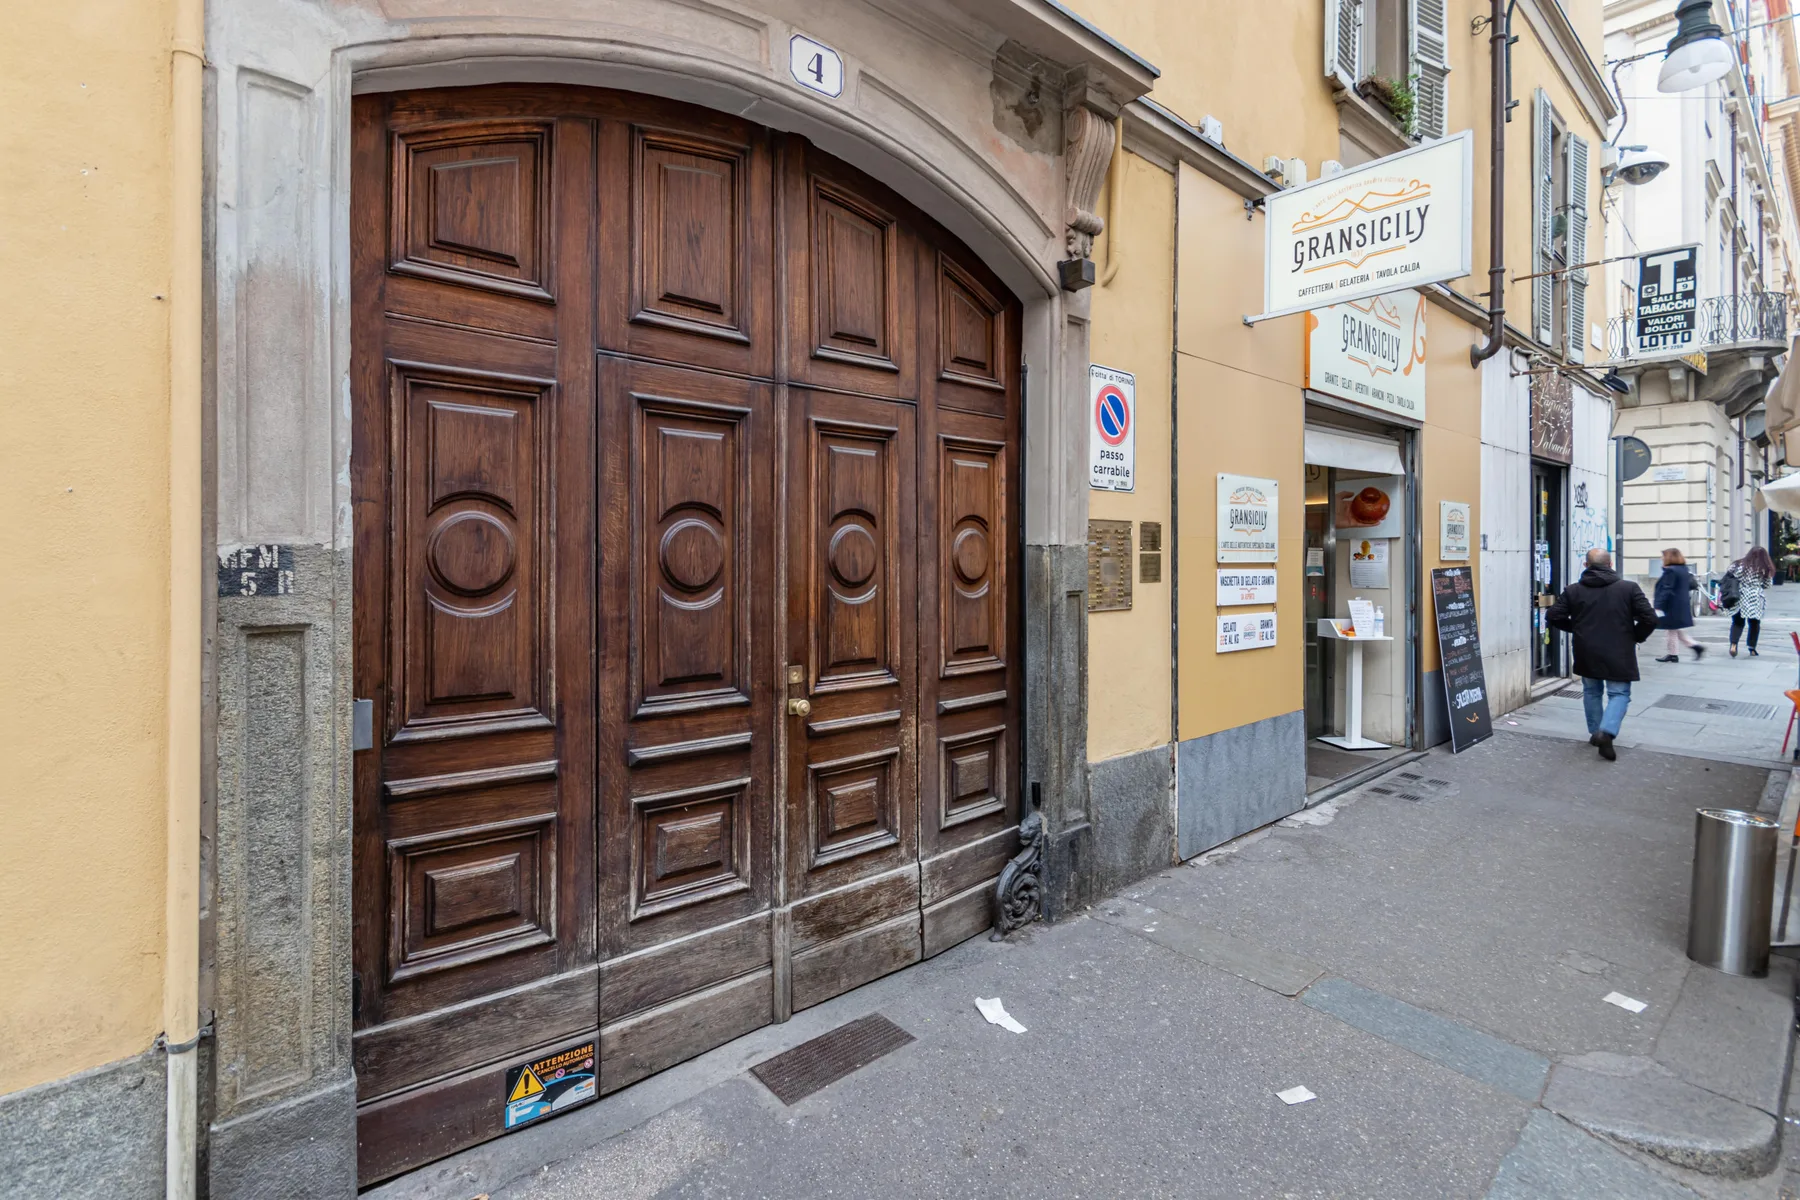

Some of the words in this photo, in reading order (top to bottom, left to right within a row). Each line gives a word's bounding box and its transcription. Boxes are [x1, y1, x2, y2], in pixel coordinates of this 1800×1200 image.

[808, 53, 823, 84] 4
[1291, 204, 1430, 274] GRANSICILY
[1298, 281, 1334, 297] CAFFETTERIA
[1339, 273, 1370, 288] GELATERIA
[1376, 266, 1399, 280] TAVOLA
[1400, 261, 1421, 276] CALDA
[1646, 250, 1690, 295] T
[1639, 298, 1695, 316] TABACCHI
[1651, 293, 1673, 304] SALI
[1676, 292, 1683, 300] E
[1645, 322, 1687, 334] BOLLATI
[1647, 314, 1685, 326] VALORI
[1341, 314, 1400, 373] GRANSICILY
[1640, 331, 1692, 349] LOTTO
[1115, 375, 1134, 386] TORINO
[1533, 420, 1571, 455] Tabacchi
[1100, 450, 1124, 461] passo
[1093, 465, 1130, 478] carrabile
[1230, 509, 1268, 531] GRANSICILY
[1219, 576, 1240, 586] VASCHETTA
[1245, 575, 1258, 586] GELATO
[1261, 575, 1275, 586] GRANITA
[1223, 622, 1237, 633] GELATO
[1260, 619, 1273, 630] GRANITA
[533, 1044, 594, 1072] ATTENZIONE
[537, 1063, 563, 1076] CANCELLO
[563, 1052, 593, 1068] AUTOMATICO
